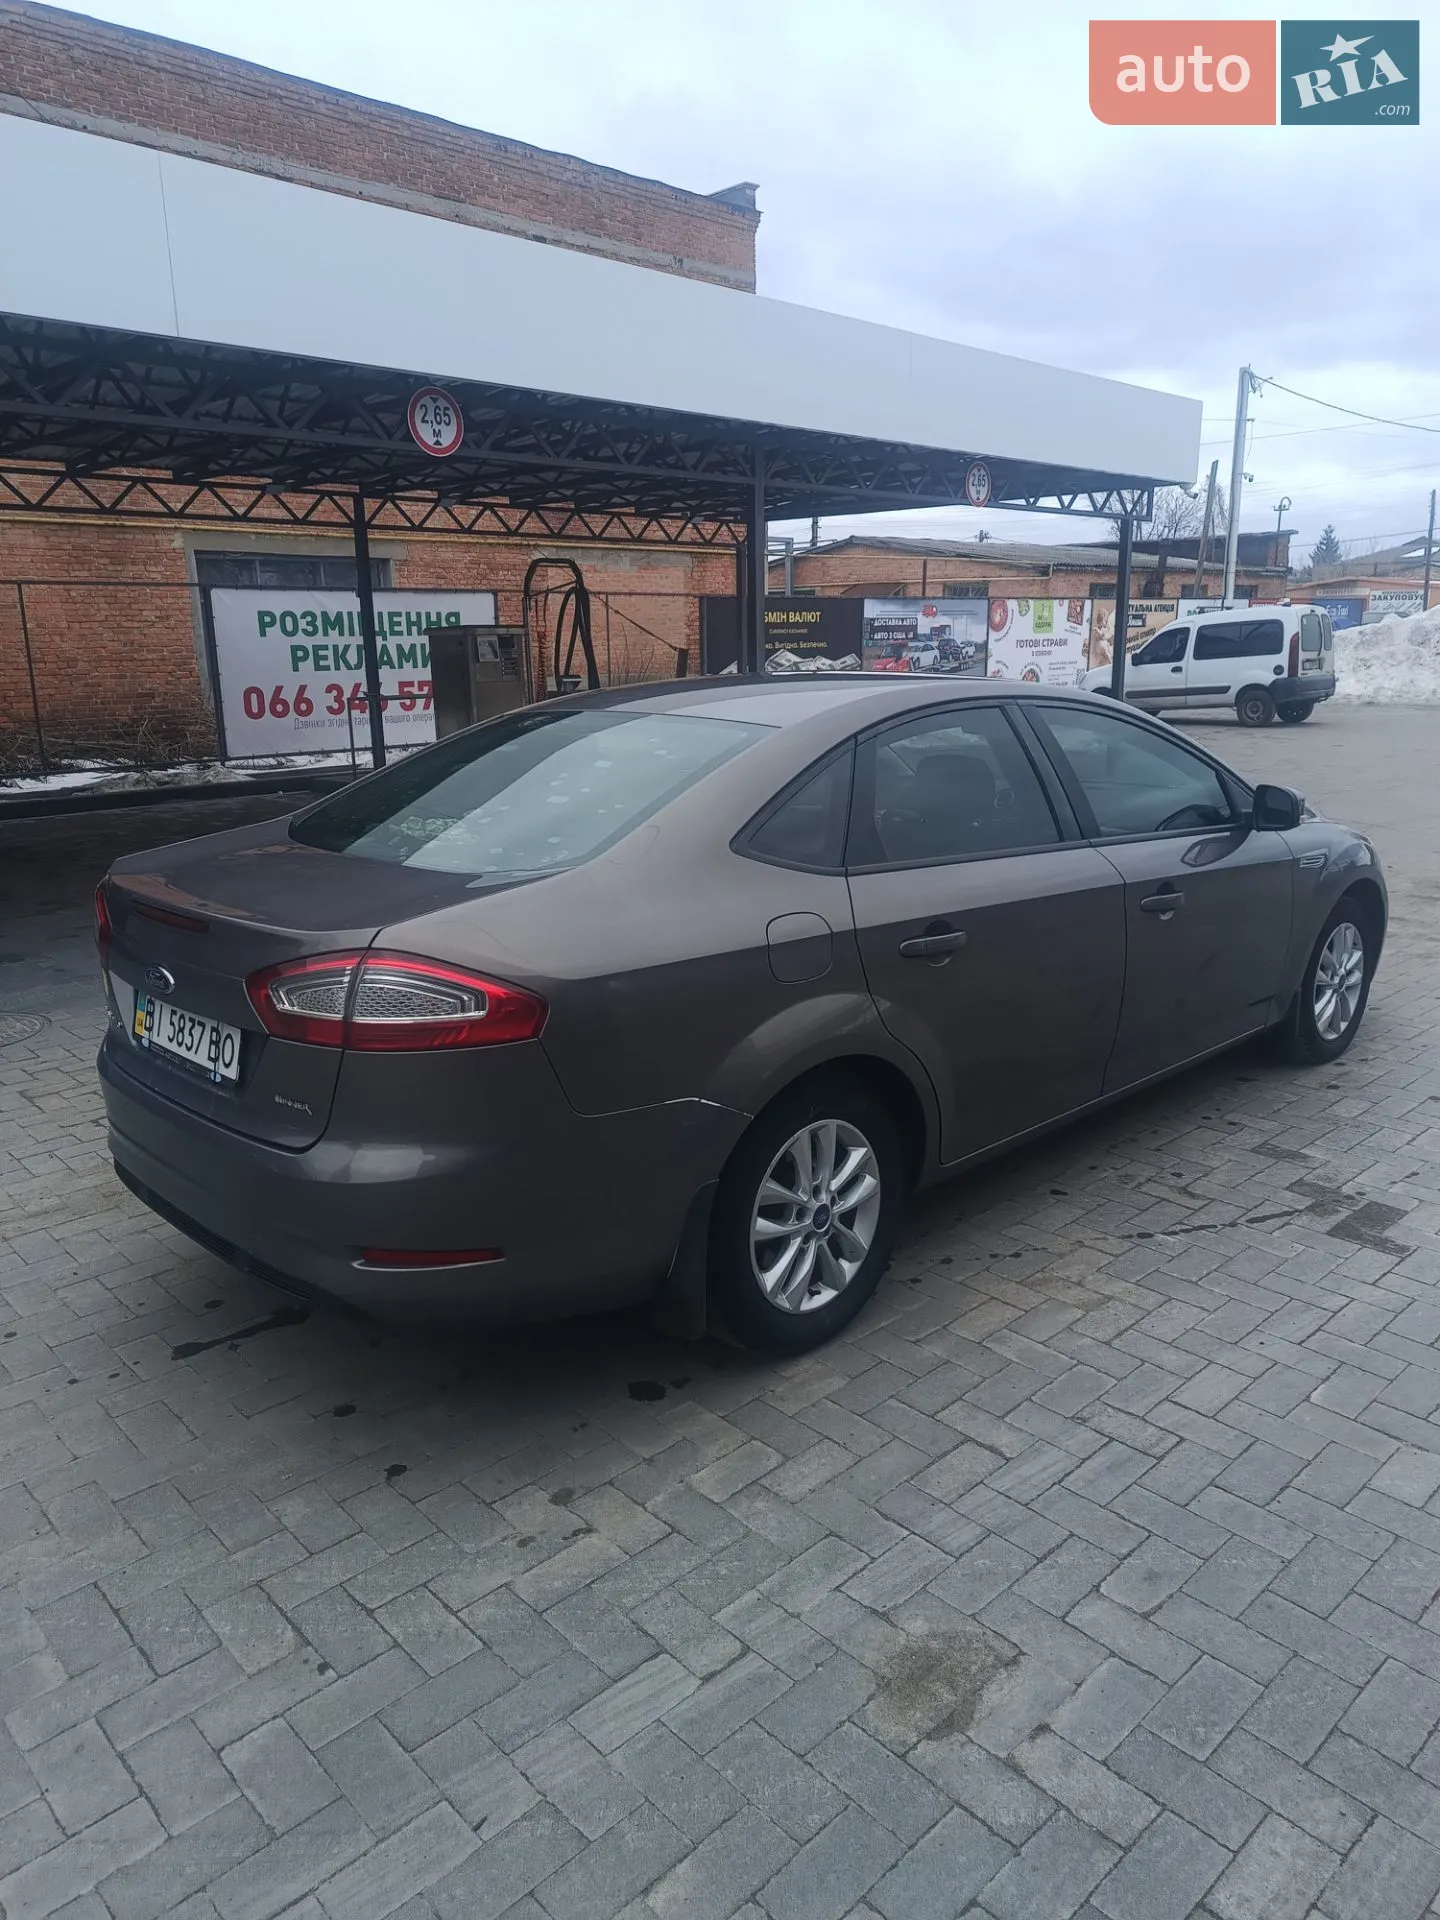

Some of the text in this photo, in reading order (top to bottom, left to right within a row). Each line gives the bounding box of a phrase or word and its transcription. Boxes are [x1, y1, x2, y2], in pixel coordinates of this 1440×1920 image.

[420, 404, 451, 429] 2,65
[789, 611, 821, 623] ВАЛЮТ
[873, 617, 917, 626] ДОСТАВКА АВТО
[873, 632, 888, 640] АВТО
[1016, 638, 1068, 648] ГОТОВІ СТРАВИ
[243, 685, 314, 720] 066
[398, 680, 433, 712] 57
[168, 1009, 206, 1055] 5837
[207, 1026, 234, 1068] BO
